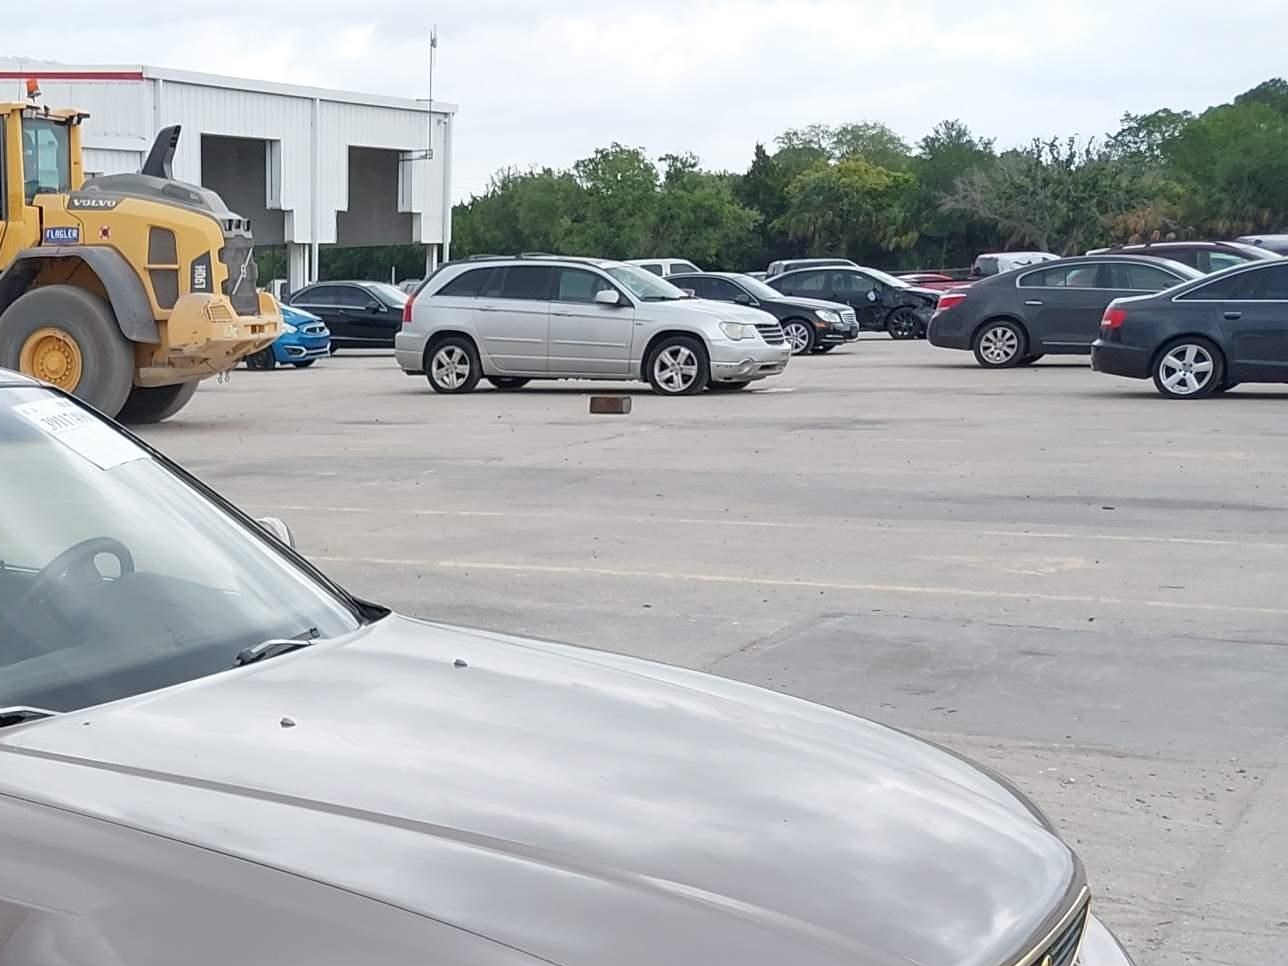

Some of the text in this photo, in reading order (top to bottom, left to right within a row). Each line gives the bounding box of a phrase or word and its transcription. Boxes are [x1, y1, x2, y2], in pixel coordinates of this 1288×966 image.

[72, 198, 117, 208] VOLVO
[46, 228, 78, 239] FLAGLER
[194, 264, 207, 289] L90H
